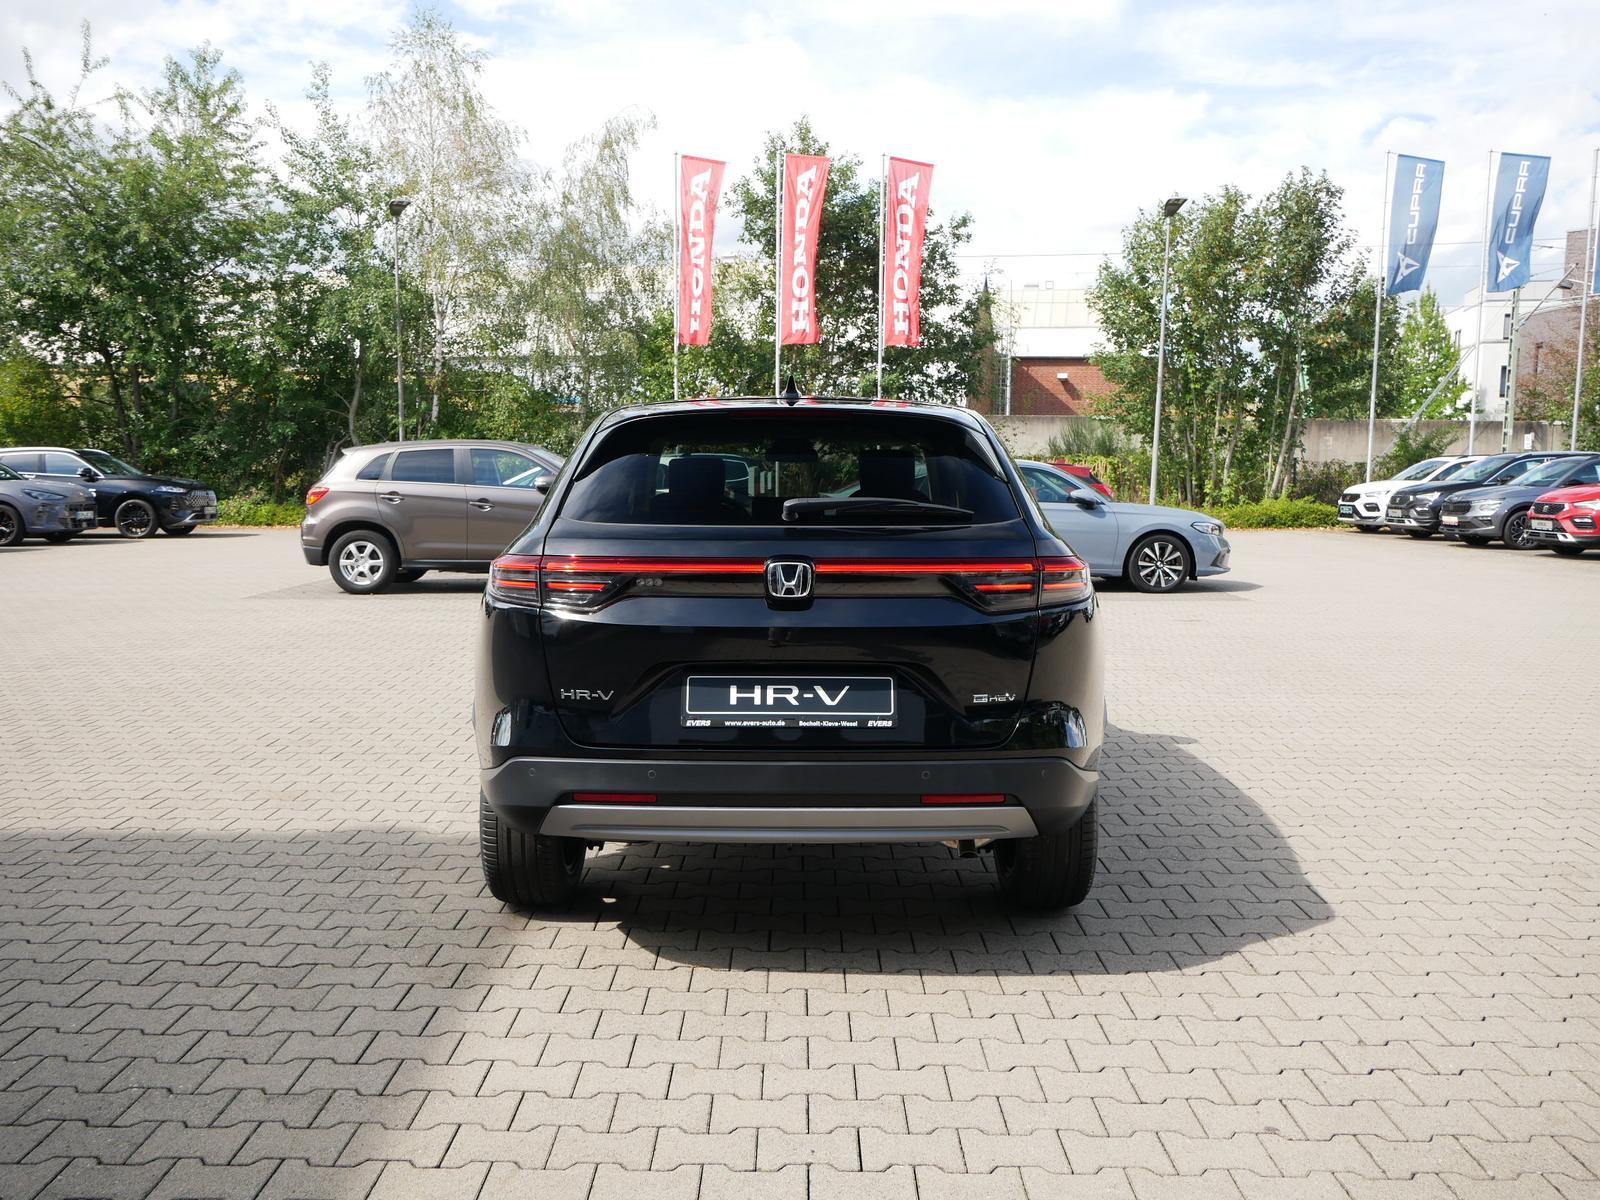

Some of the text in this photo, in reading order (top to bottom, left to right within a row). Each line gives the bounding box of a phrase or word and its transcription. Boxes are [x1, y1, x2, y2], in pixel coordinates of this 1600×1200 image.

[1407, 163, 1427, 245] CUPRA
[1505, 160, 1531, 244] CUPRA
[689, 167, 712, 333] HONDA
[791, 165, 817, 333] HONDA
[893, 172, 919, 335] HONDA
[560, 688, 614, 700] HR-V
[729, 685, 850, 706] HR-V
